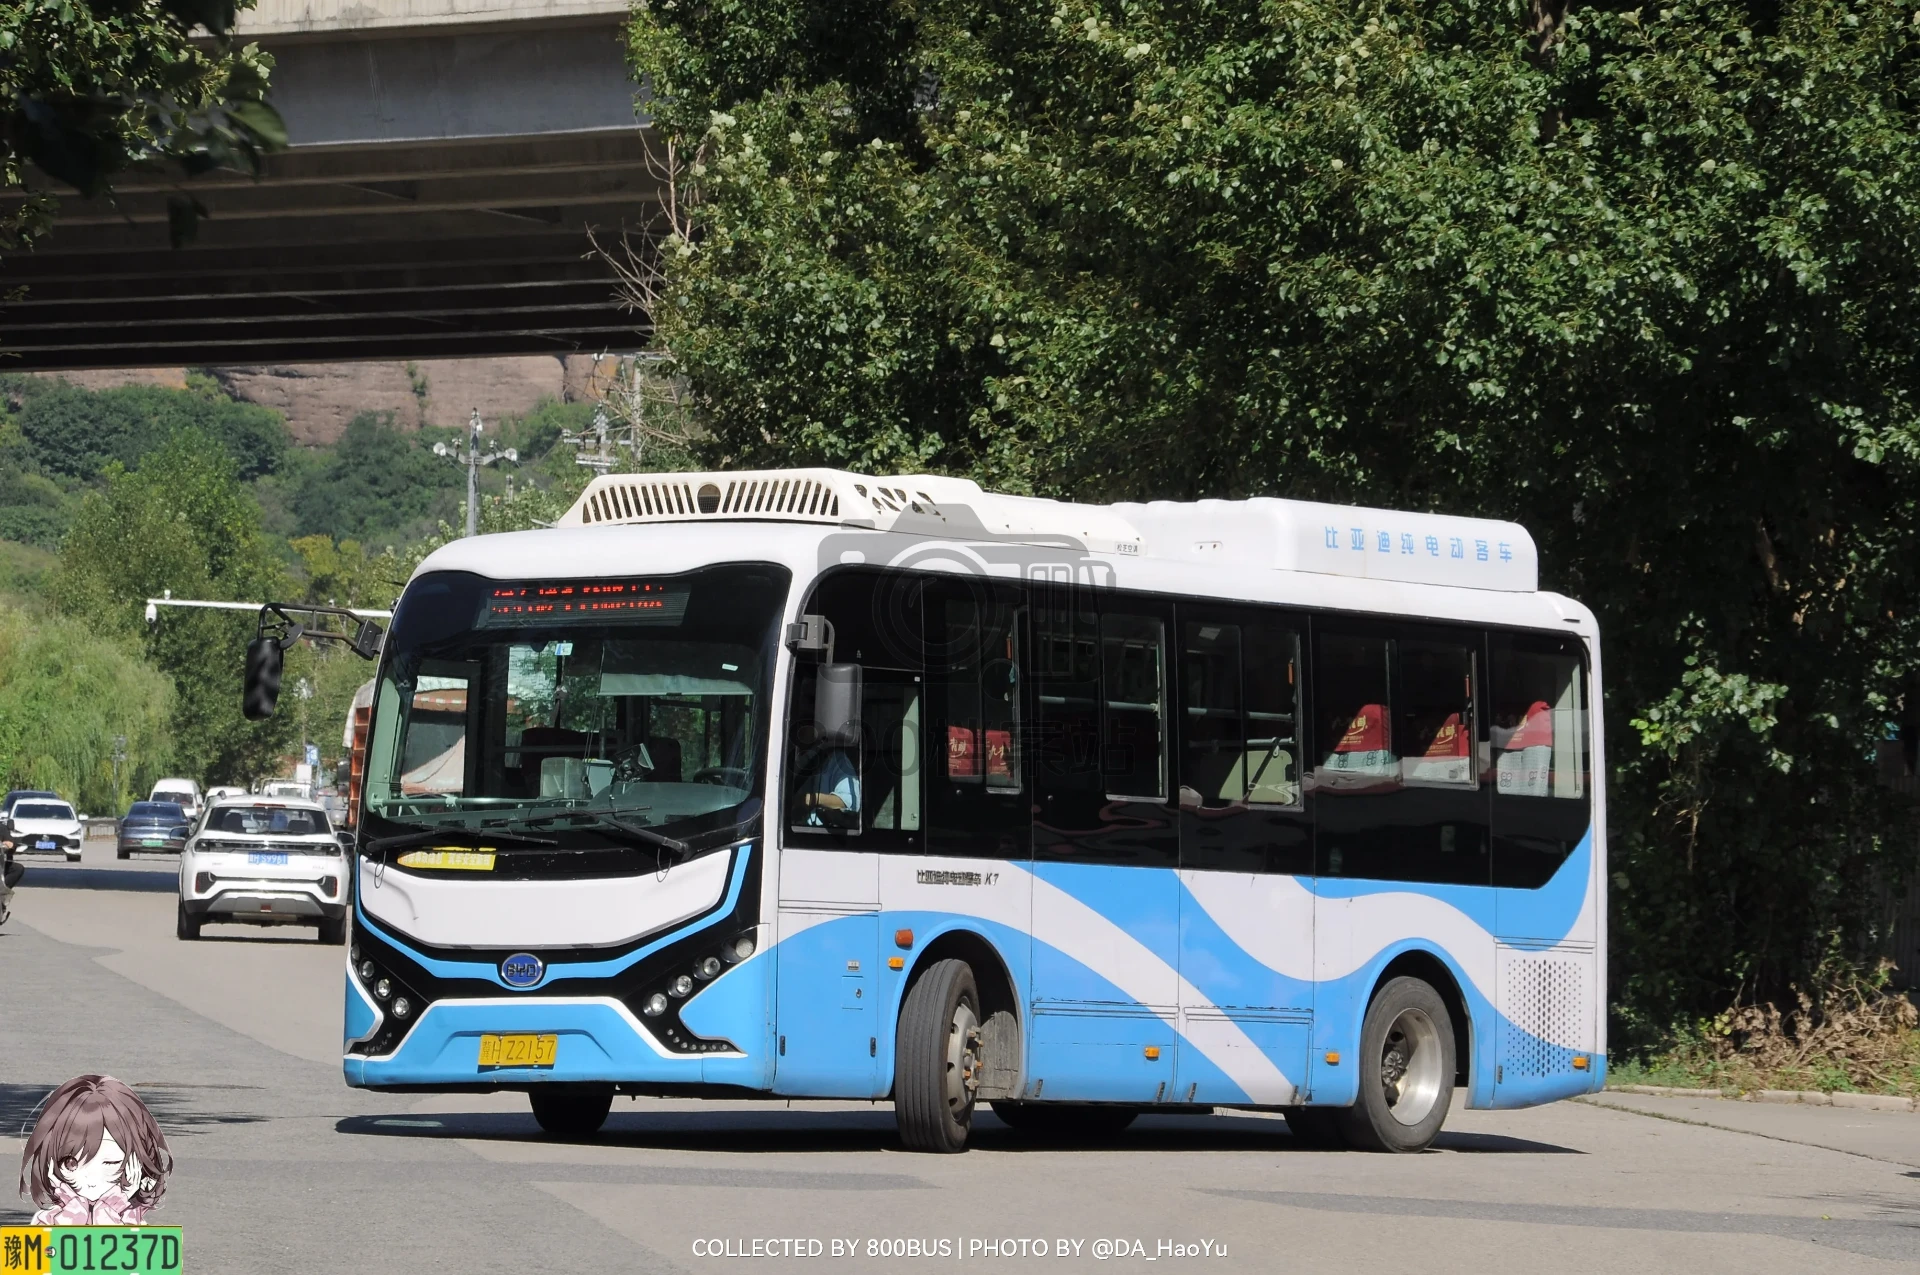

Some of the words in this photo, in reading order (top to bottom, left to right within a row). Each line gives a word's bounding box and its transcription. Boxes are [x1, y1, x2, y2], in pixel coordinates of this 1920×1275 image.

[1324, 525, 1513, 563] 比亚迪纯电动客车
[984, 872, 1000, 886] K7
[506, 963, 538, 977] BYD
